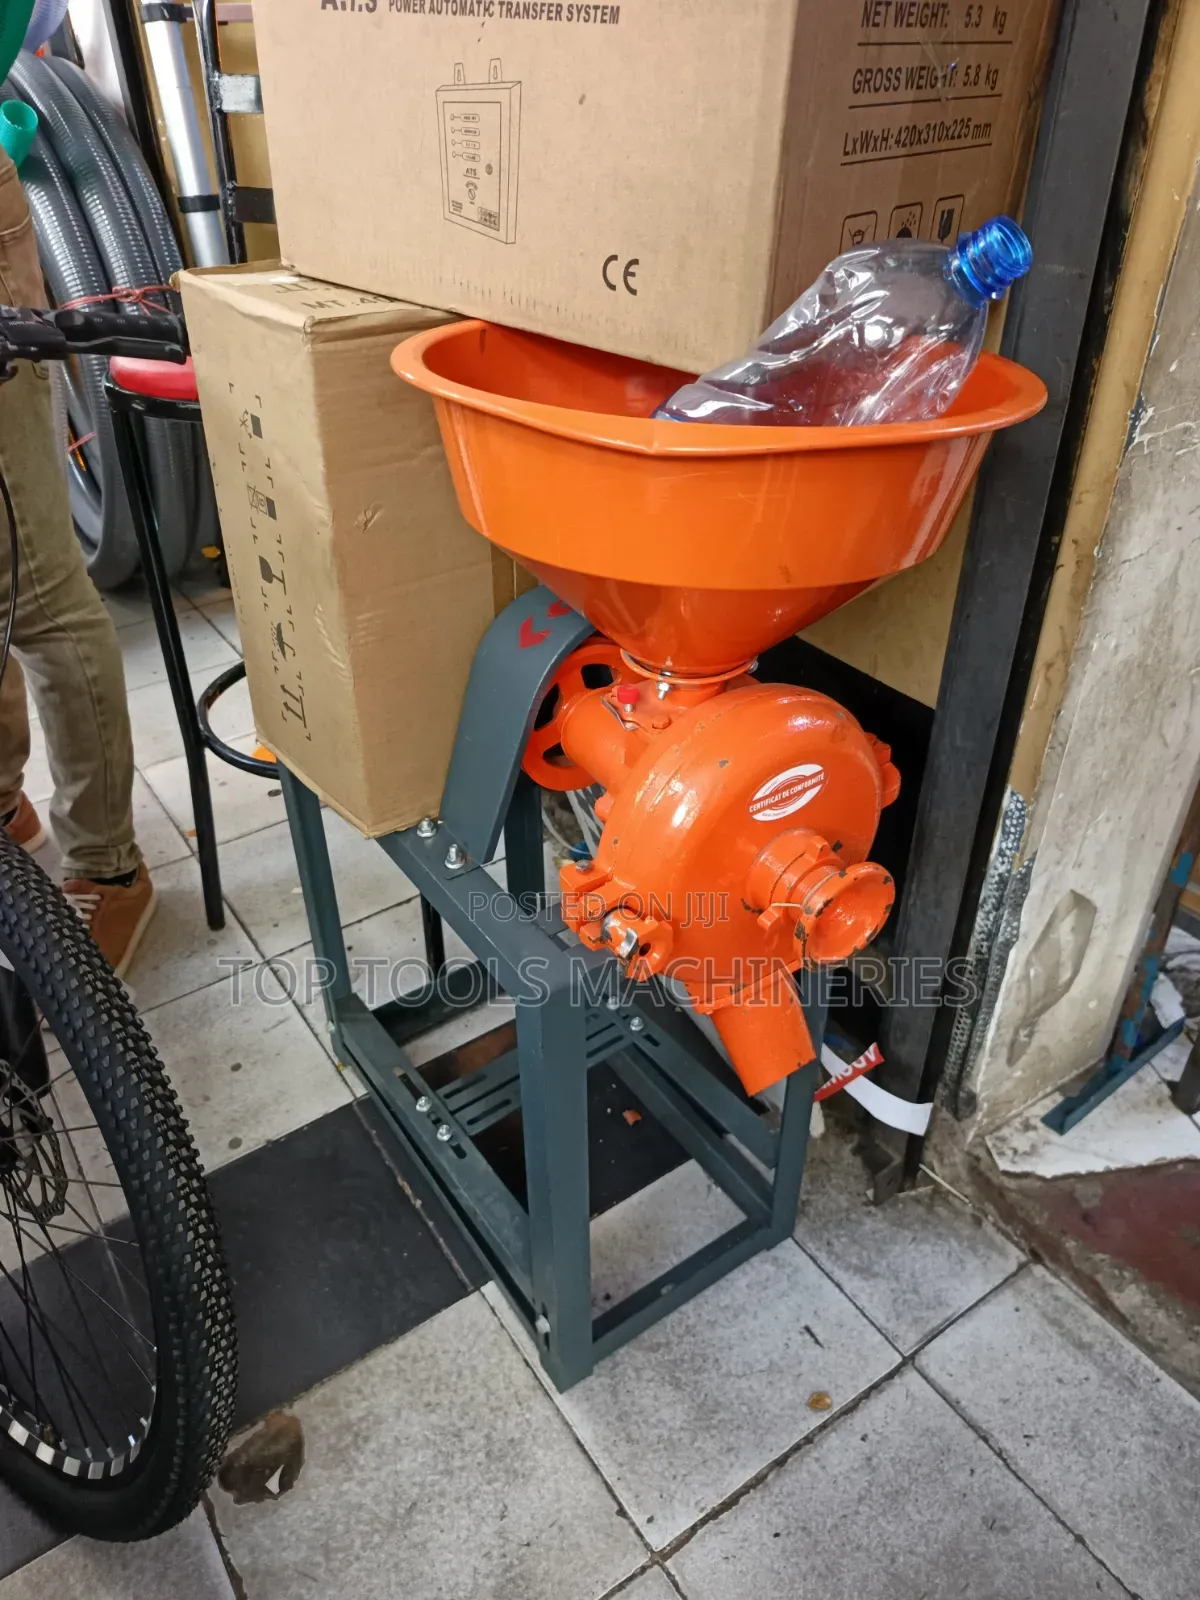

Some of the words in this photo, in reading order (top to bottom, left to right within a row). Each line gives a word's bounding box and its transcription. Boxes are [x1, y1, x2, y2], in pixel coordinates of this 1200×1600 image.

[389, 0, 426, 15] POWER
[428, 0, 495, 18] AUTOMATIC
[498, 1, 563, 21] TRANSFER
[566, 3, 620, 24] SYSTEM
[861, 1, 891, 28] NET
[893, 1, 950, 28] WEIGHT:
[964, 4, 983, 28] 5.3
[992, 2, 1007, 34] kg
[852, 66, 901, 95] GROSS
[963, 63, 980, 87] 5.8
[985, 63, 999, 91] kg
[602, 254, 640, 297] CE
[749, 792, 782, 813] CERTIFICAT
[782, 789, 790, 798] DE
